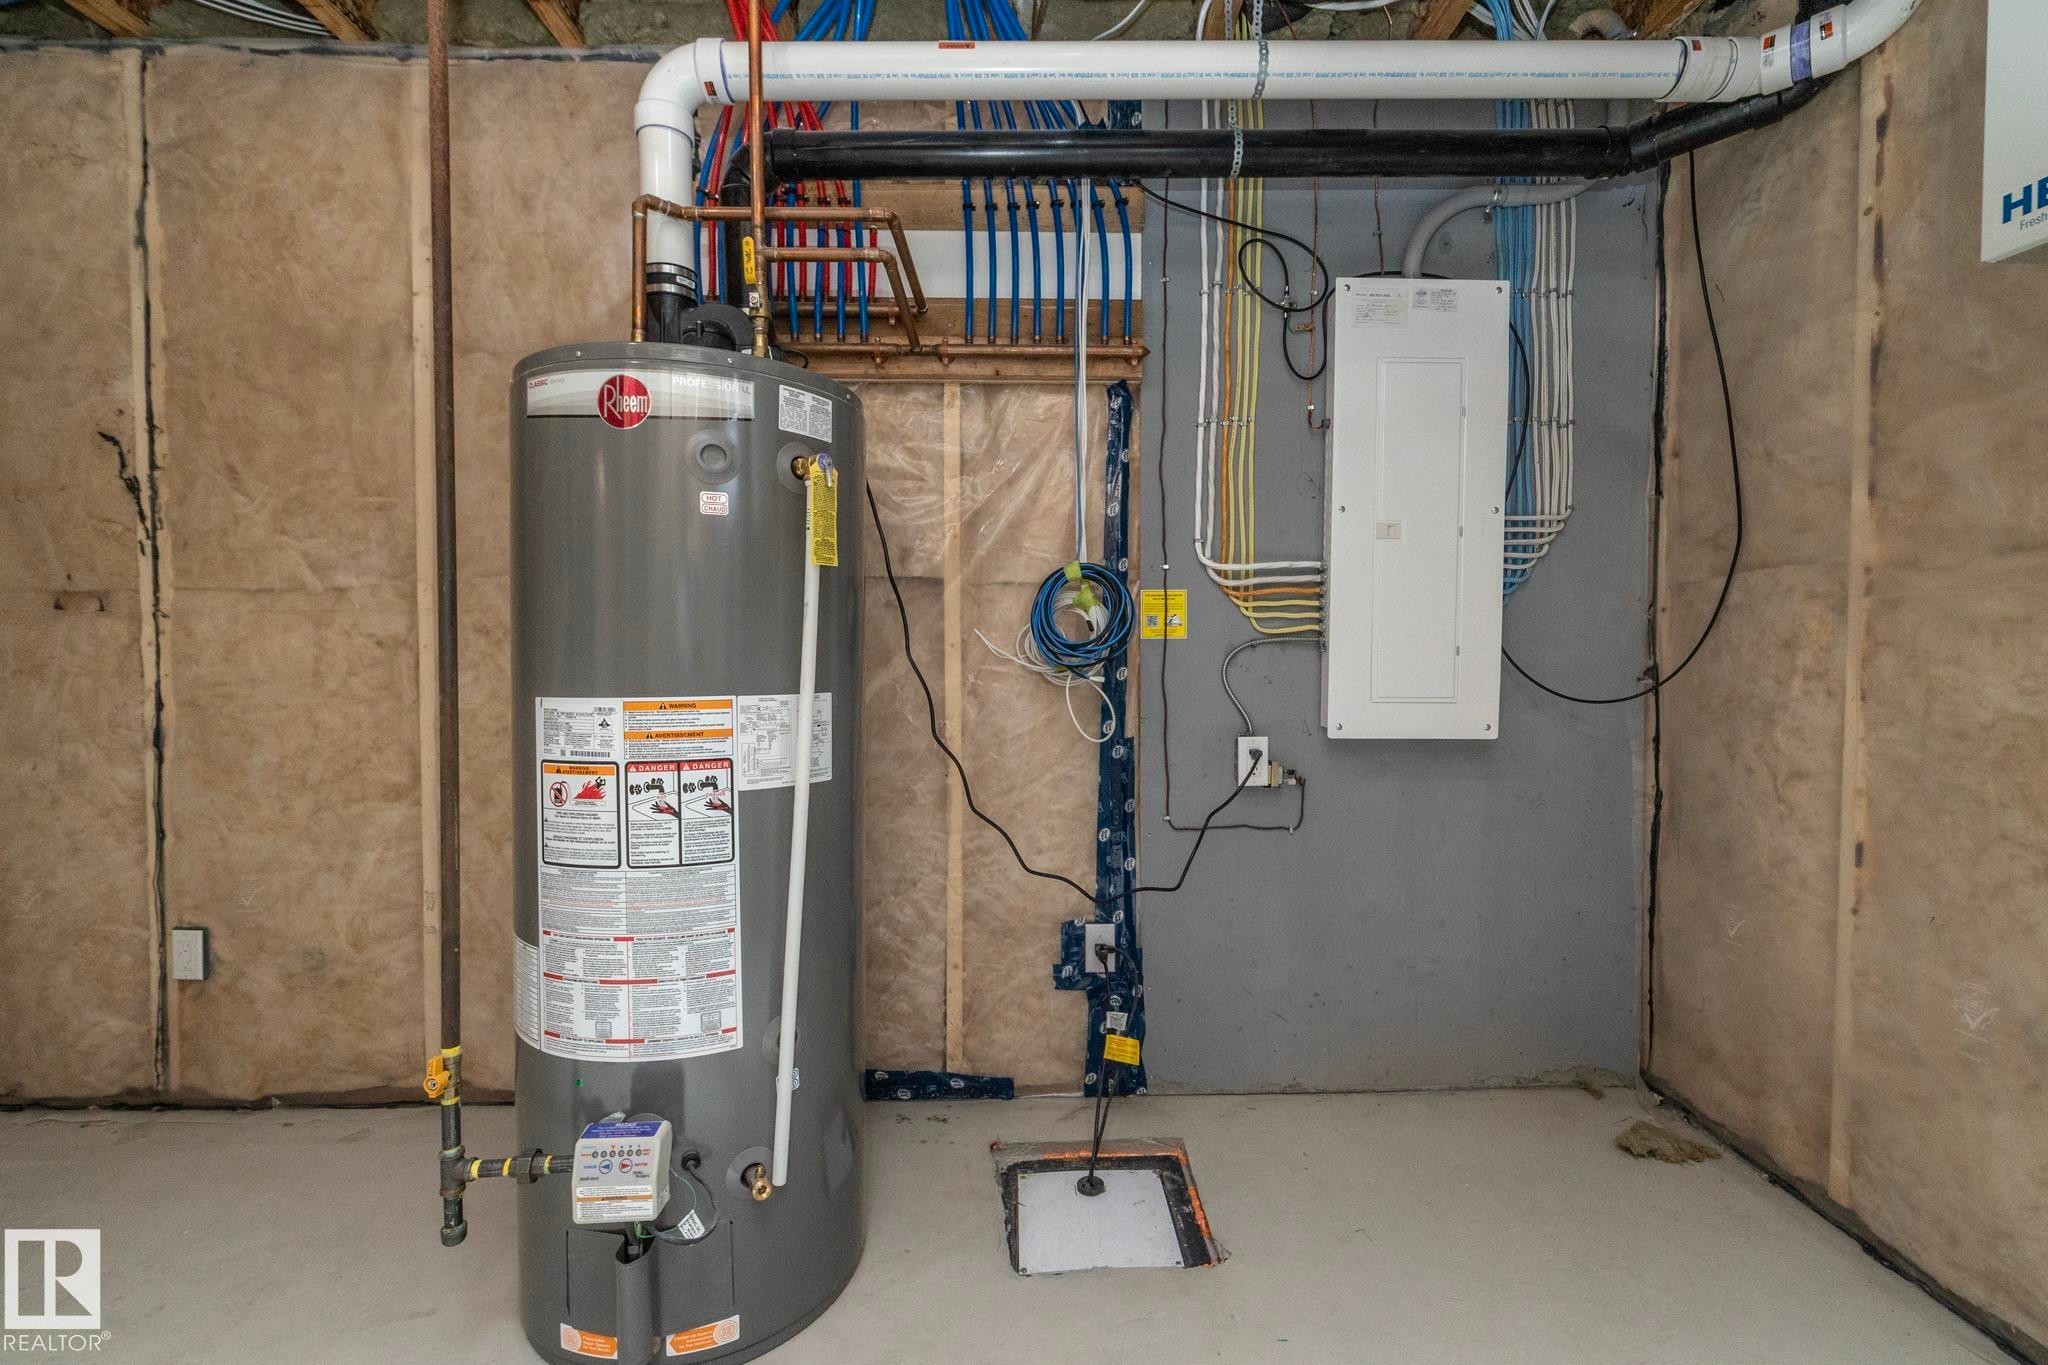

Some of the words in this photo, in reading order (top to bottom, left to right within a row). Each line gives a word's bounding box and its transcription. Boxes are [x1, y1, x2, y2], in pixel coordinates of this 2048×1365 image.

[2020, 212, 2048, 231] Fresh
[528, 379, 548, 389] CLASSIC
[672, 377, 751, 394] PROFESSIONAL
[603, 375, 648, 420] Rheem
[692, 762, 729, 770] DANGER
